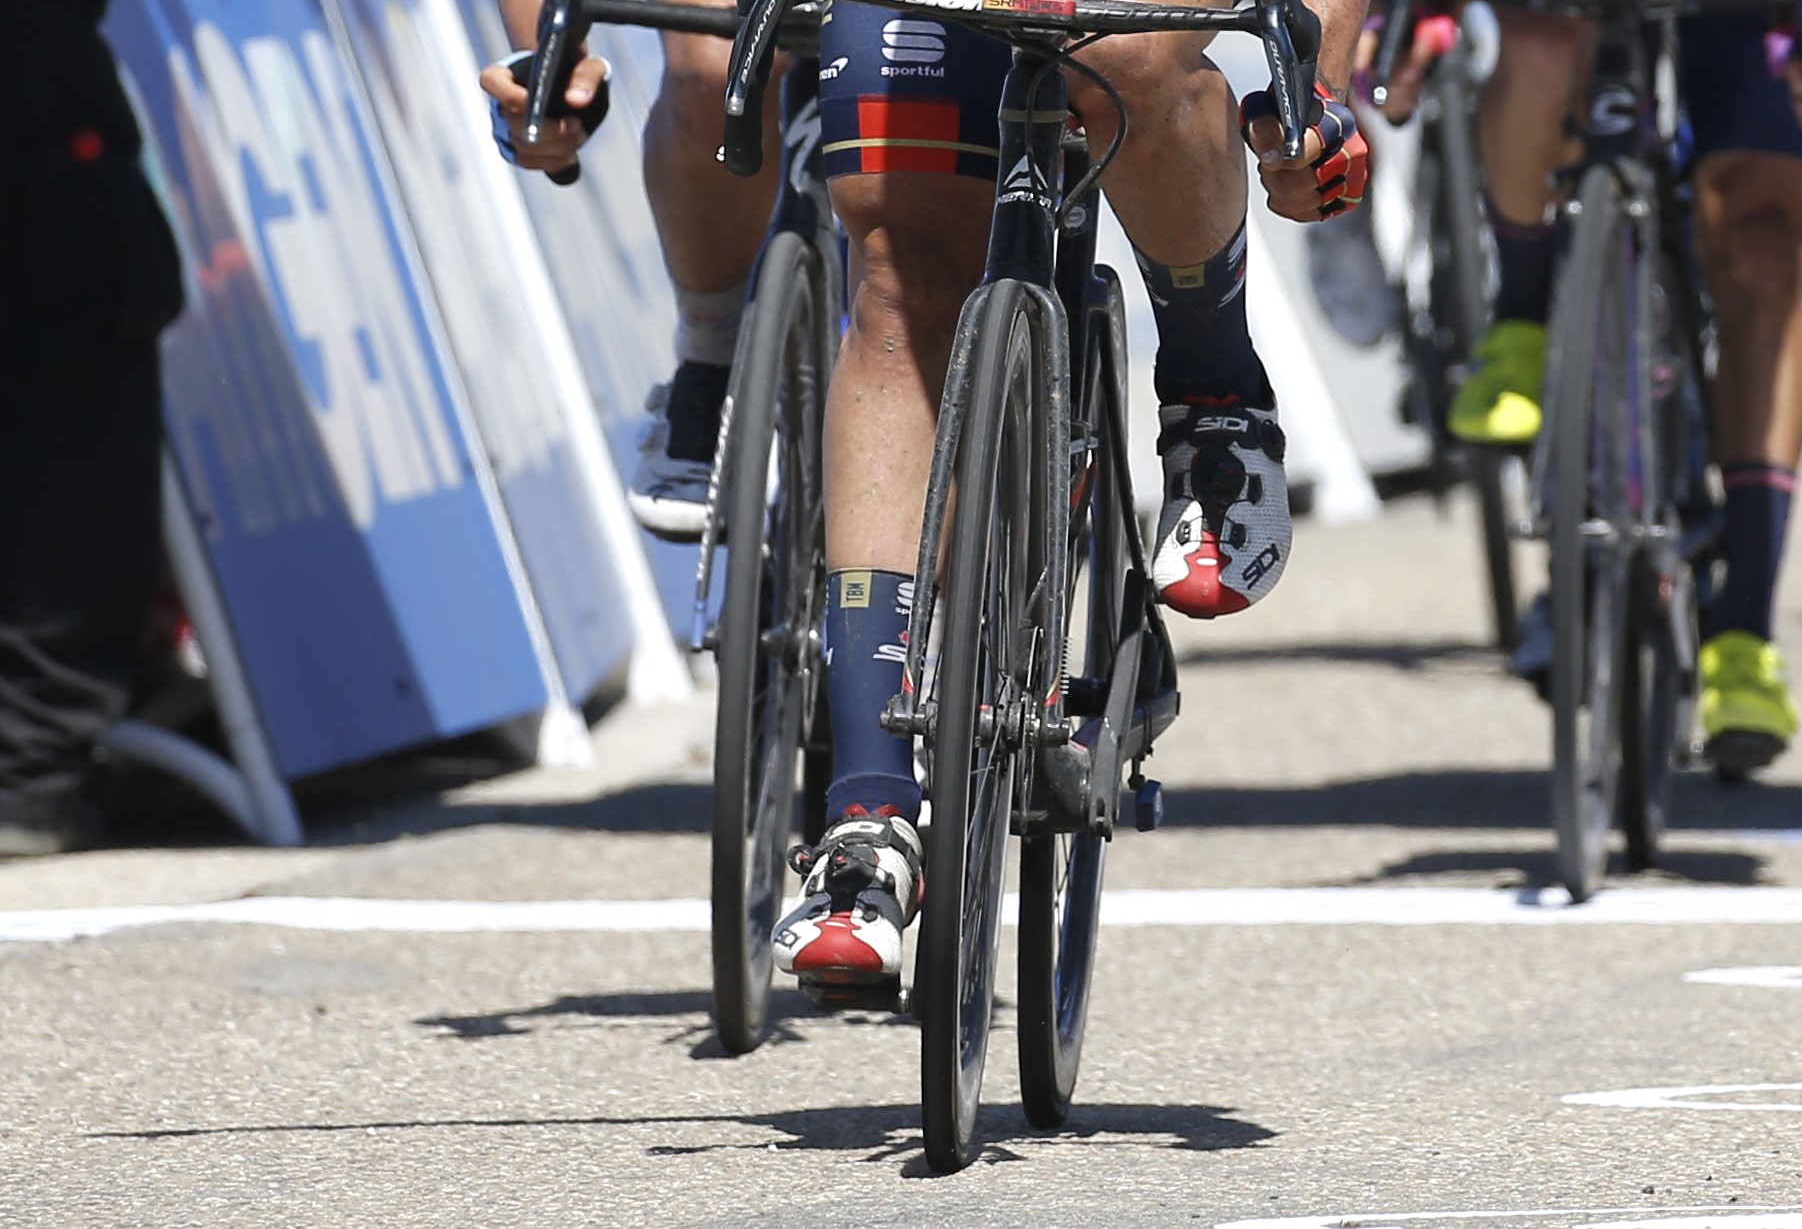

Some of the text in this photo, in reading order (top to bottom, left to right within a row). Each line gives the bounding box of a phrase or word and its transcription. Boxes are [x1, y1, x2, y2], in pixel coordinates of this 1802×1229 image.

[880, 66, 945, 78] sportful
[1195, 416, 1250, 433] SIDI
[1241, 543, 1281, 590] SIDI
[845, 582, 865, 603] TBM
